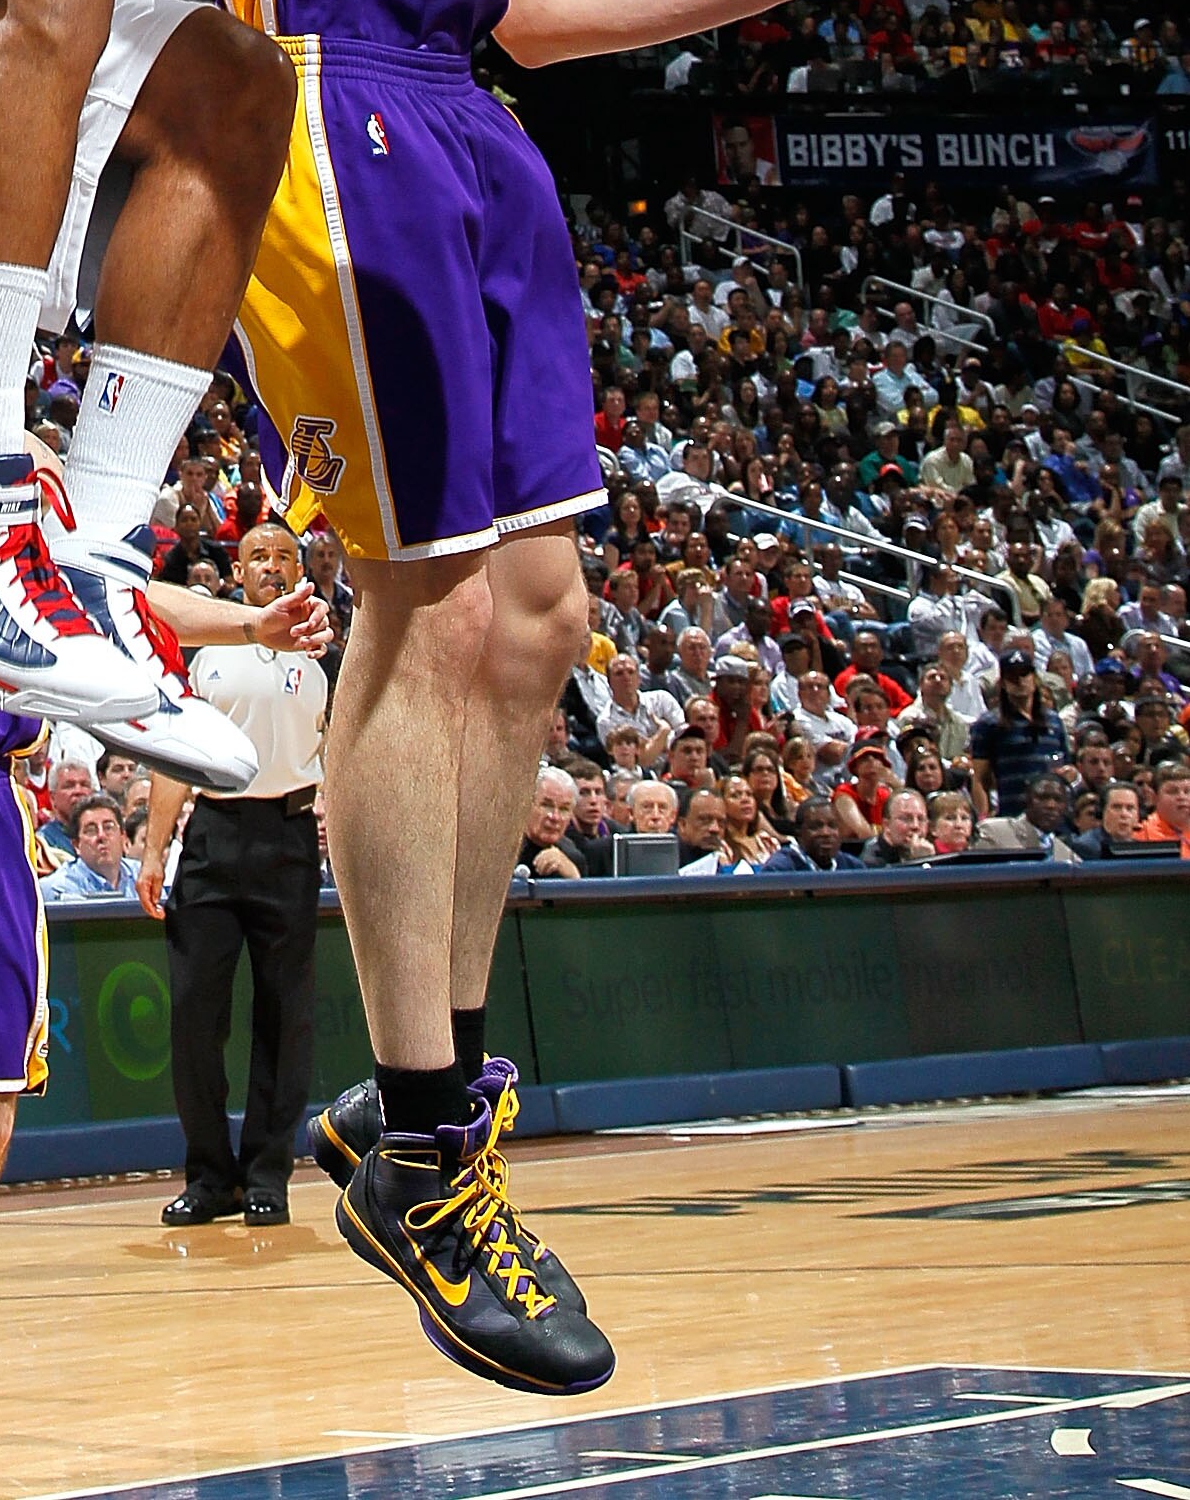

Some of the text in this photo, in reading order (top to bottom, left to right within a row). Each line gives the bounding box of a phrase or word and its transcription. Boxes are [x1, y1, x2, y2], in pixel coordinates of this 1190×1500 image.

[786, 132, 1058, 169] BIBBY'S BUNCH
[1165, 129, 1190, 151] 11
